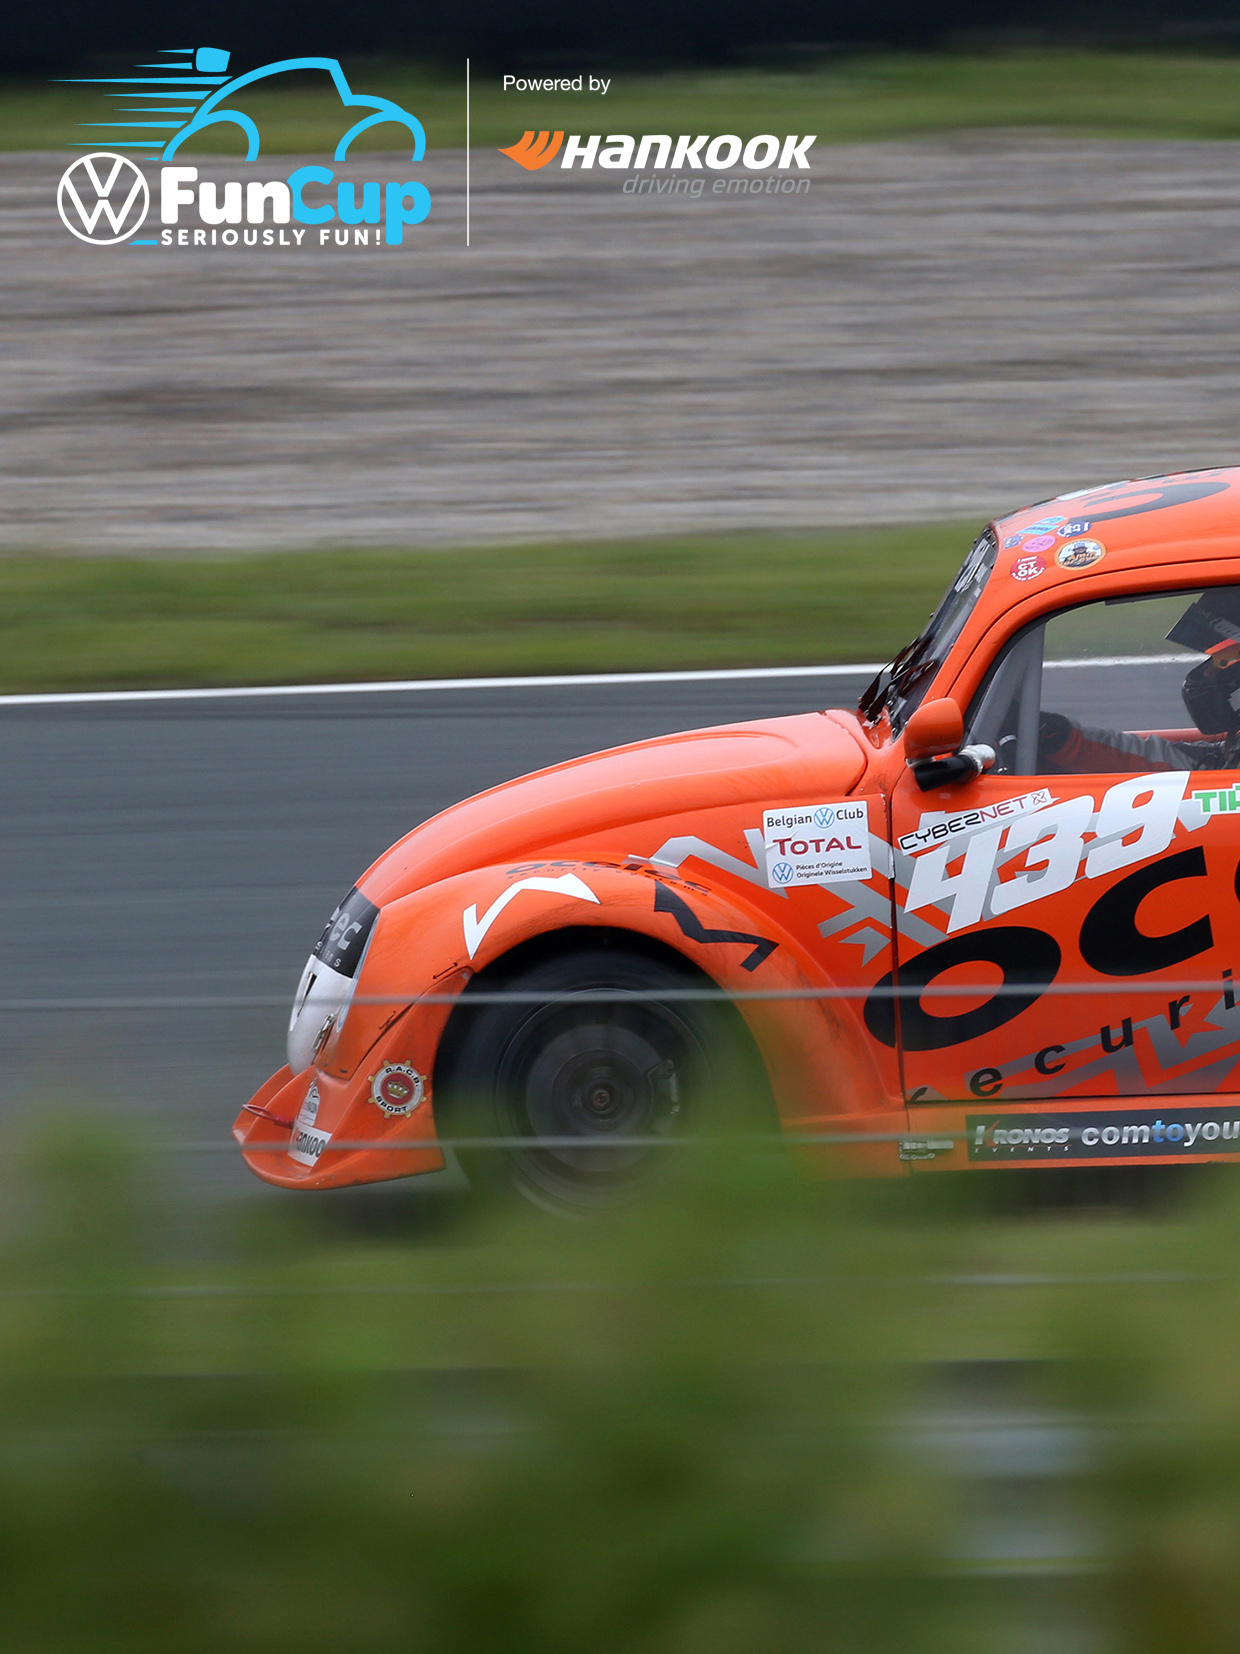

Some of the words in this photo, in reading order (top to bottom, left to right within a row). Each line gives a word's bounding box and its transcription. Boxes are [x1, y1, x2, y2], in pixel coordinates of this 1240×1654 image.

[767, 814, 812, 828] Belgian
[836, 808, 864, 820] Club
[772, 836, 862, 856] TOTAL
[903, 771, 1190, 934] 439
[796, 862, 815, 870] Pièces
[815, 861, 843, 869] d'Origine
[797, 870, 824, 879] Originele
[825, 867, 867, 875] Wisselstukken
[376, 1095, 407, 1112] SPORT
[974, 1121, 1070, 1146] KRONOS
[1081, 1119, 1240, 1147] comtoyou
